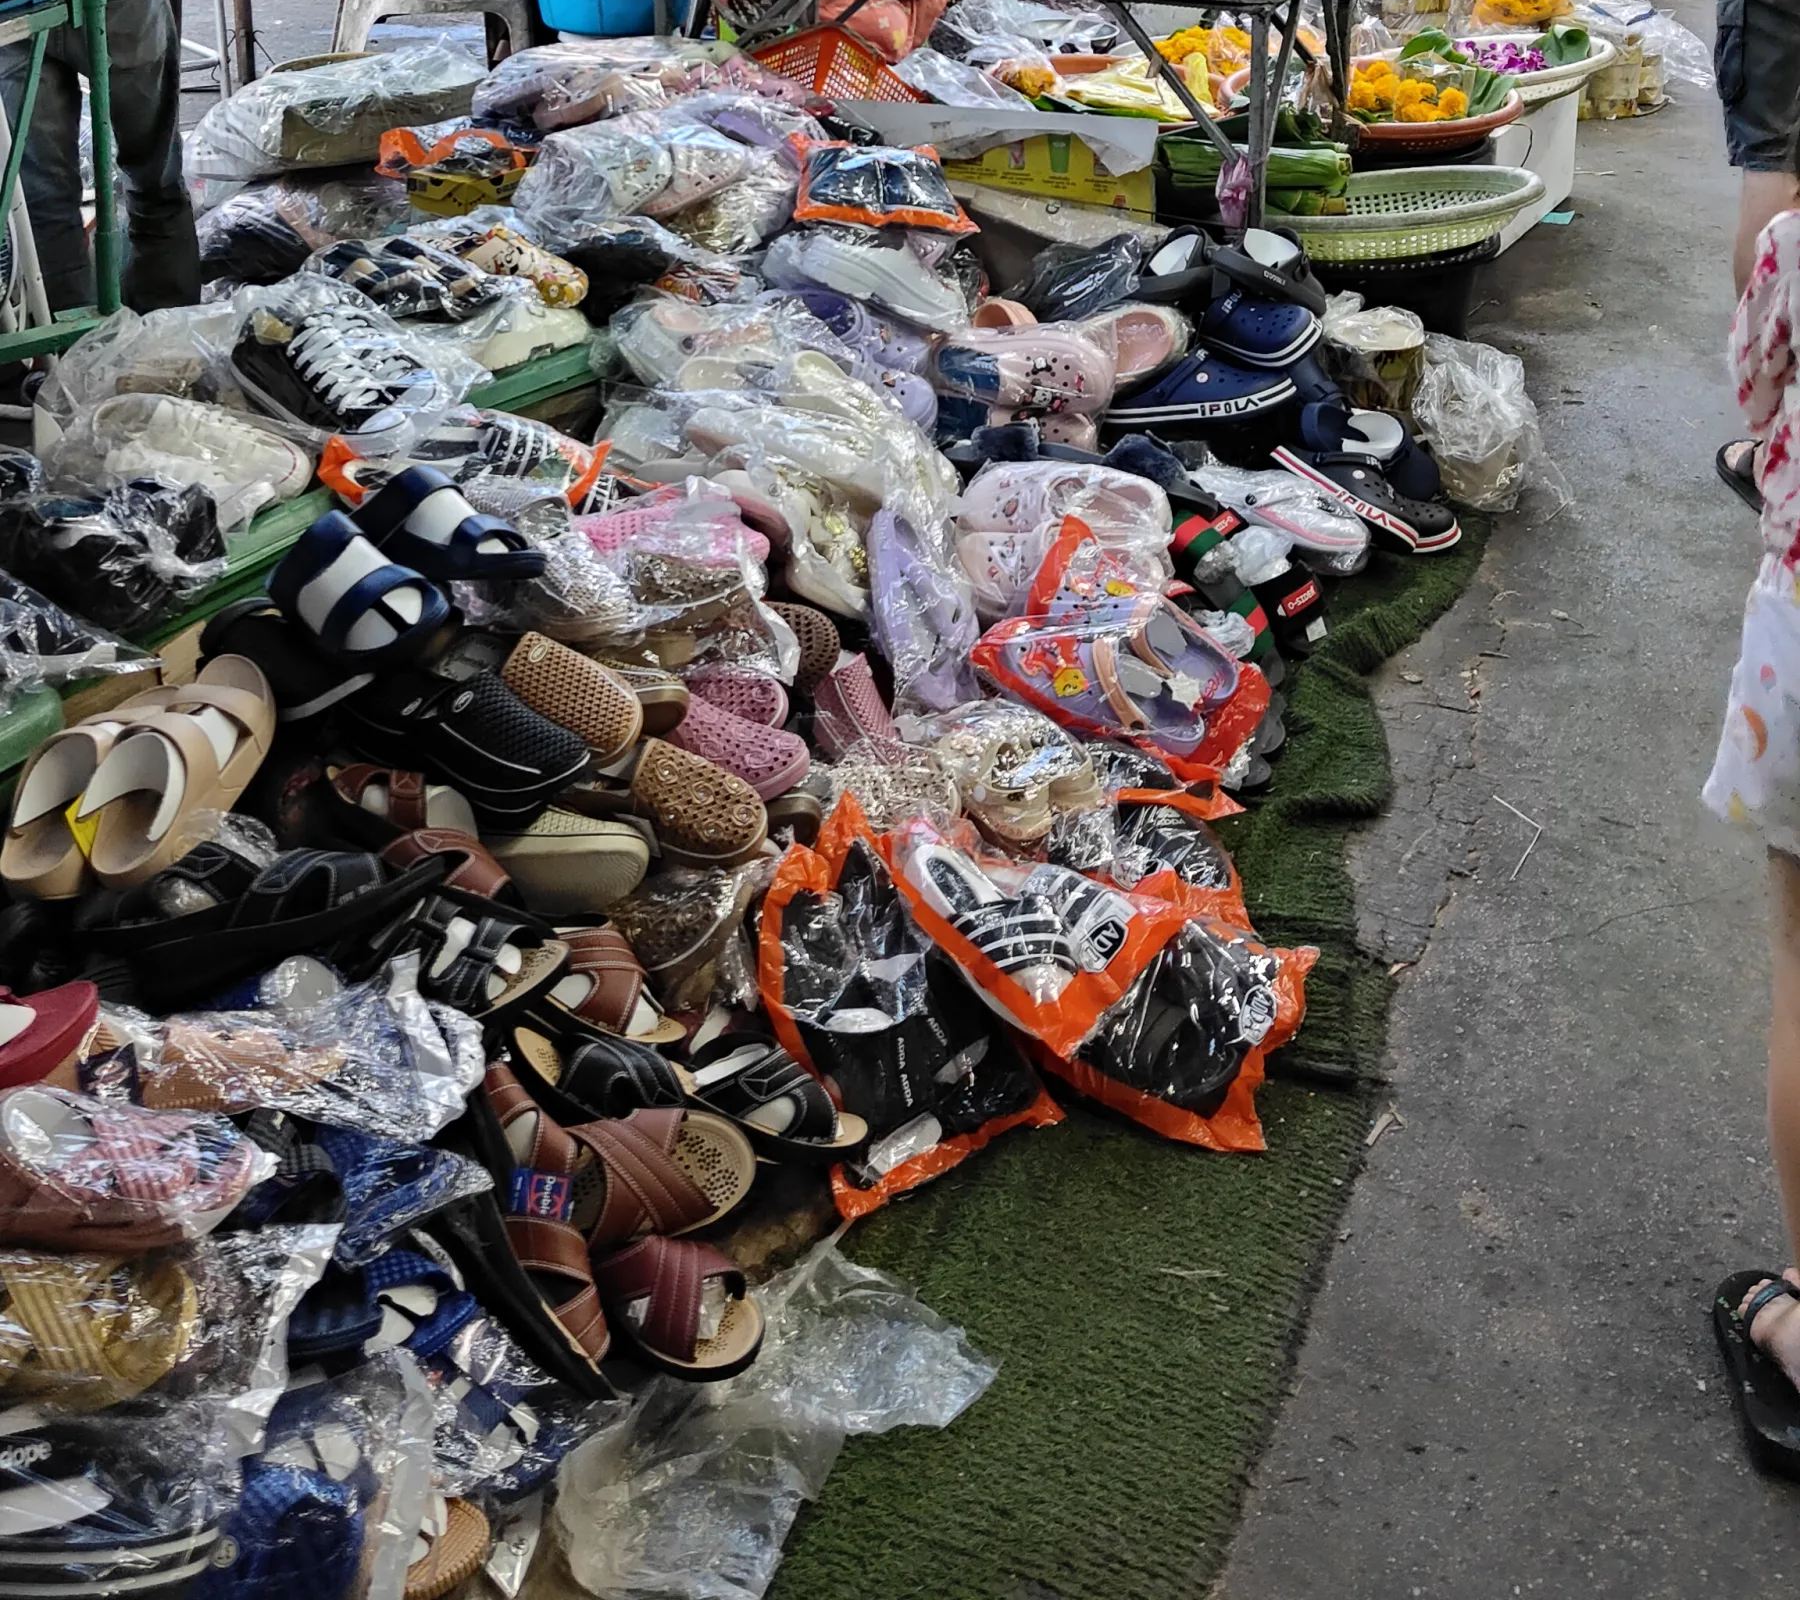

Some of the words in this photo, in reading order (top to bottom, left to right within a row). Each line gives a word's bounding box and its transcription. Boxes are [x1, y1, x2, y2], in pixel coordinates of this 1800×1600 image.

[927, 1017, 948, 1047] ADDA
[897, 1036, 906, 1070] ADDA
[900, 1073, 914, 1108] ADDA
